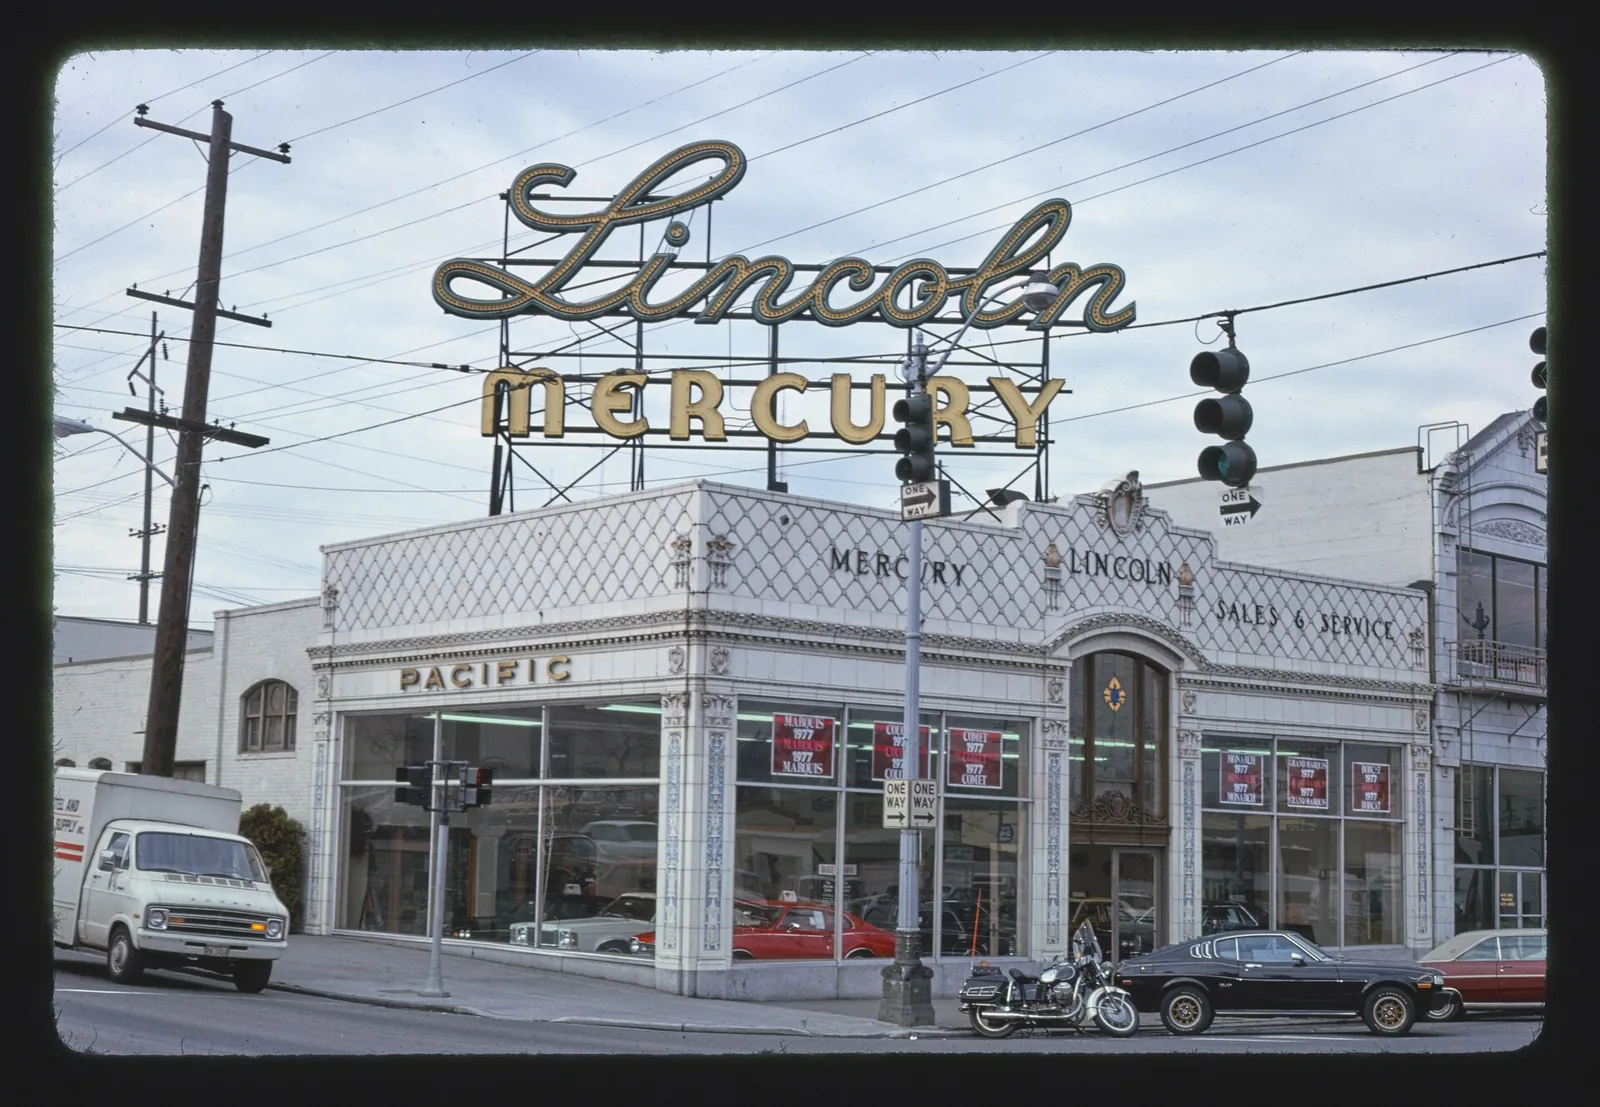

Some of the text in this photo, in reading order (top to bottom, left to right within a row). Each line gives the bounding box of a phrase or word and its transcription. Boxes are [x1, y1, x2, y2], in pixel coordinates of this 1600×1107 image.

[431, 139, 1137, 333] Lincoln
[480, 366, 1067, 449] MERCURY
[905, 483, 925, 496] ONE
[1221, 490, 1246, 503] ONE
[906, 505, 926, 517] WAY
[1223, 515, 1247, 527] WAY
[1070, 548, 1171, 586] LINCOLN
[1216, 601, 1279, 627] SALES
[1321, 613, 1395, 641] SERVICE
[400, 655, 571, 692] PACIFIC
[784, 715, 825, 730] MARQUIS
[793, 728, 815, 740] 1977
[963, 731, 989, 743] COMET
[893, 736, 904, 747] 197
[966, 742, 984, 753] 1977
[792, 751, 814, 762] 1977
[783, 761, 824, 775] MARQUIS
[892, 758, 904, 769] 197
[965, 763, 984, 775] 1977
[1234, 764, 1249, 774] 1977
[961, 774, 988, 786] COMET
[1301, 769, 1314, 779] 1977
[1365, 774, 1378, 784] 1977
[887, 783, 906, 795] ONE
[914, 783, 935, 795] ONE
[1233, 783, 1248, 793] 1977
[1300, 787, 1314, 797] 1977
[886, 796, 906, 808] WAY
[1365, 791, 1378, 801] 1977
[913, 796, 935, 809] WAY
